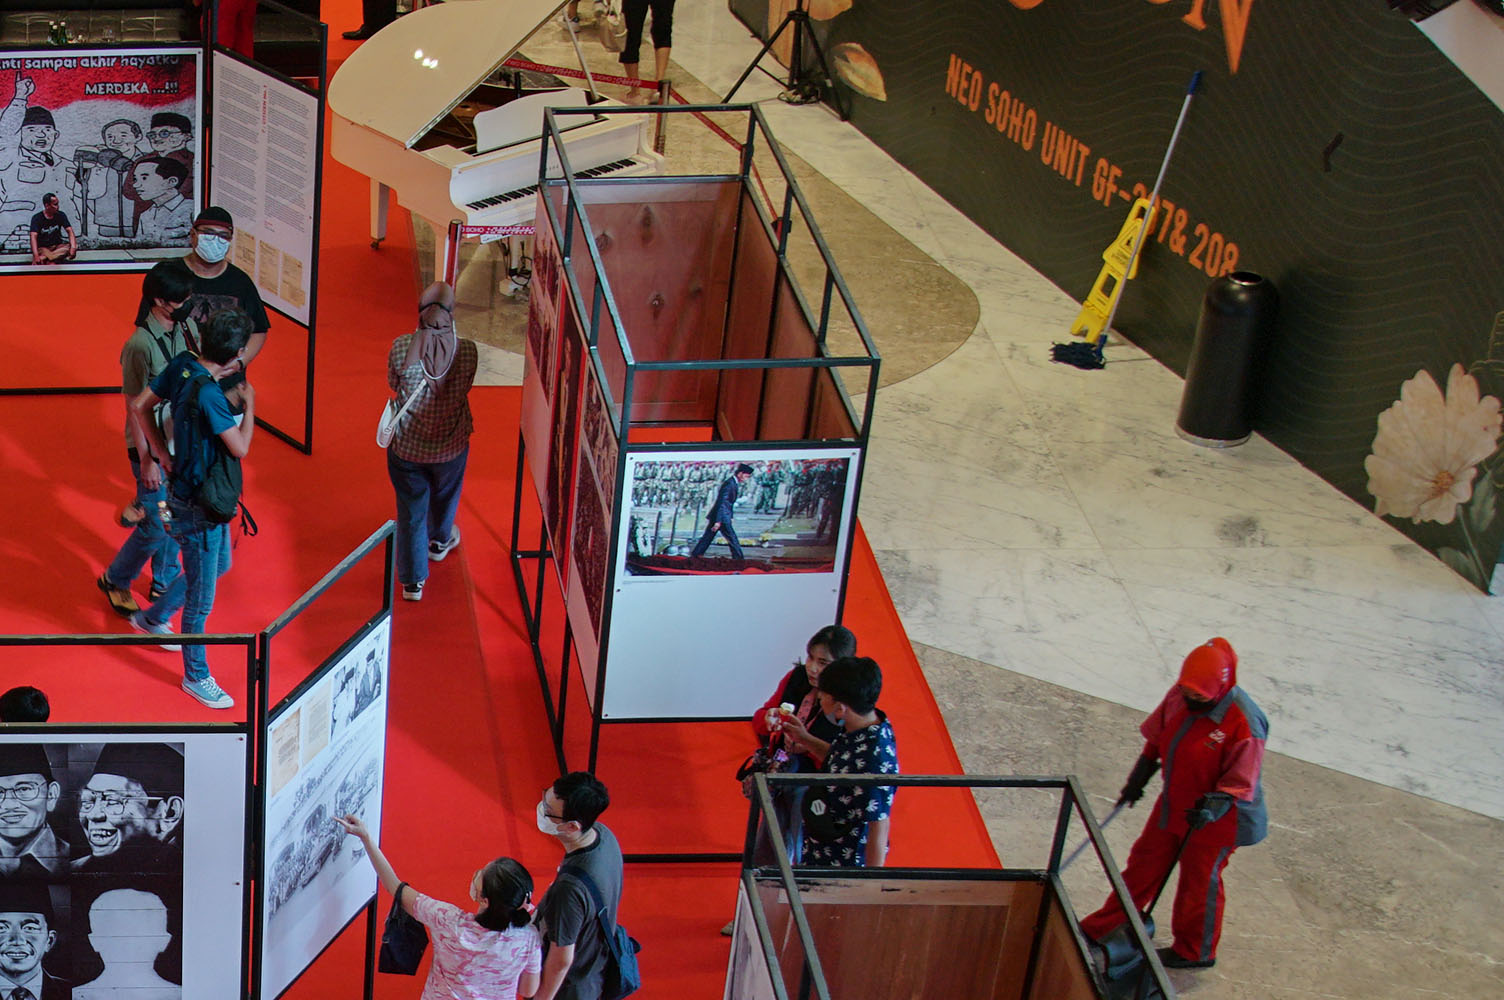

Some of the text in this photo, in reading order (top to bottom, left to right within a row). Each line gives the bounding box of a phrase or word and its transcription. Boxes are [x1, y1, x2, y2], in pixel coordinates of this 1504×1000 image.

[25, 57, 77, 72] sampai
[80, 55, 117, 68] akhir
[85, 83, 149, 95] MERDEKA
[946, 53, 983, 112] NEO
[985, 82, 1038, 151] SOHO
[1041, 121, 1091, 187] UNIT
[1188, 223, 1240, 278] 208
